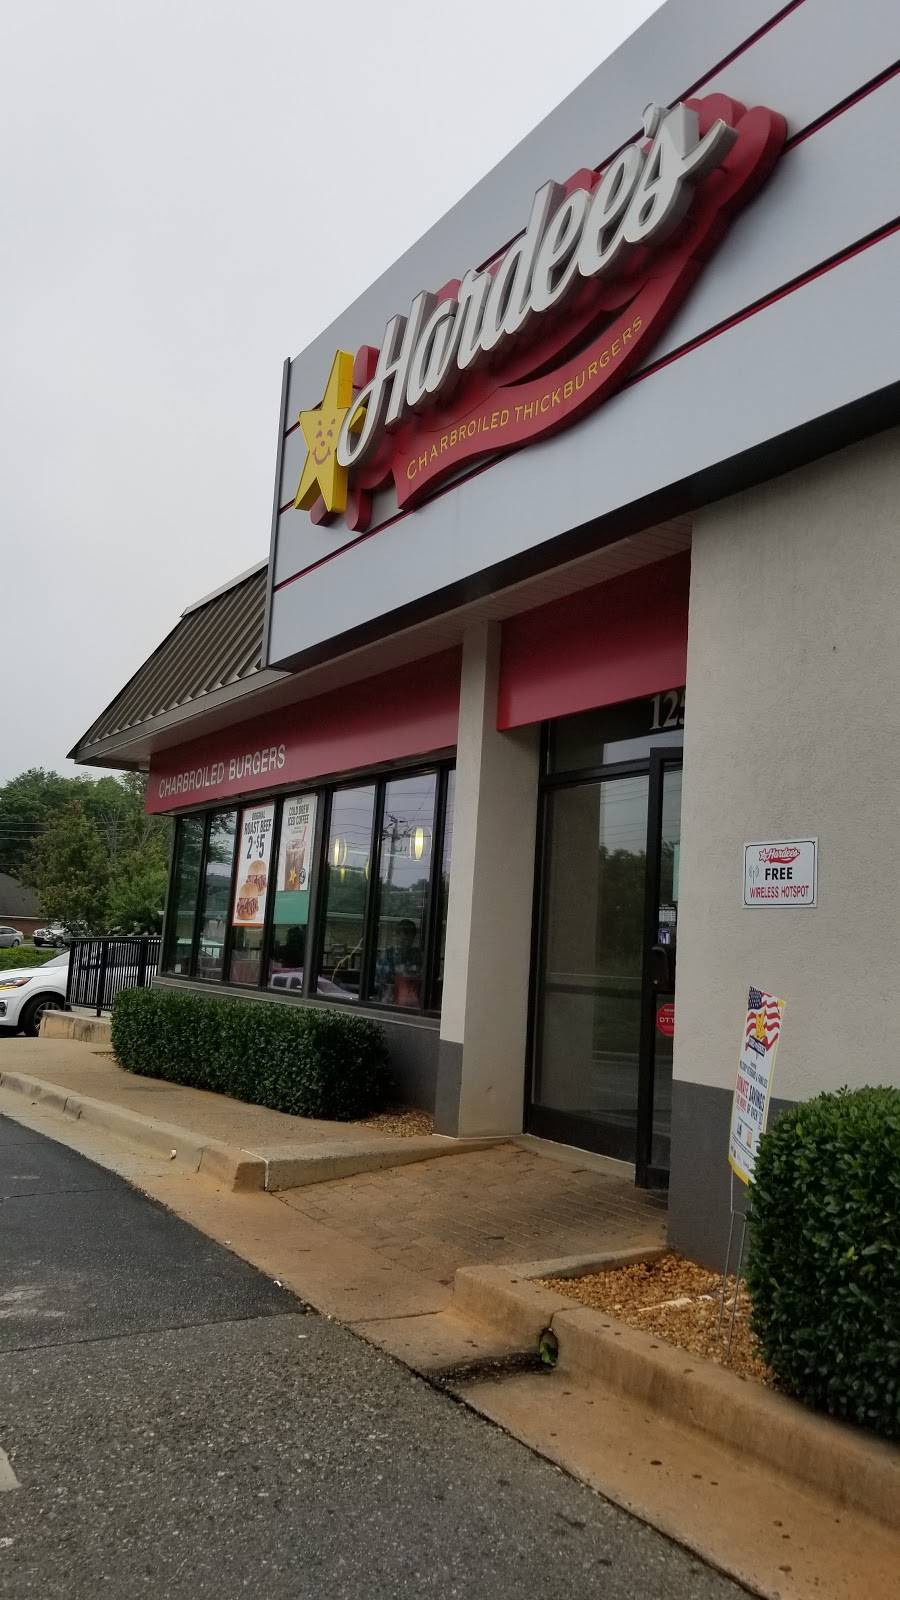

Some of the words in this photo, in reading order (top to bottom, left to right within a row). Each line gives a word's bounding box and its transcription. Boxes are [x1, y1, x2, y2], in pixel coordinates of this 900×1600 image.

[336, 102, 737, 466] Hardee's
[406, 410, 510, 480] CHARBROILED
[514, 316, 643, 424] THICKBURGERS
[159, 762, 225, 798] CHARBROILED
[229, 744, 286, 780] BURGERS
[244, 821, 260, 835] ROAST
[260, 819, 271, 833] BEEF
[246, 835, 254, 859] 2
[765, 867, 793, 881] FREE
[750, 886, 780, 899] WIRELESS
[781, 885, 809, 898] HOTSPOT
